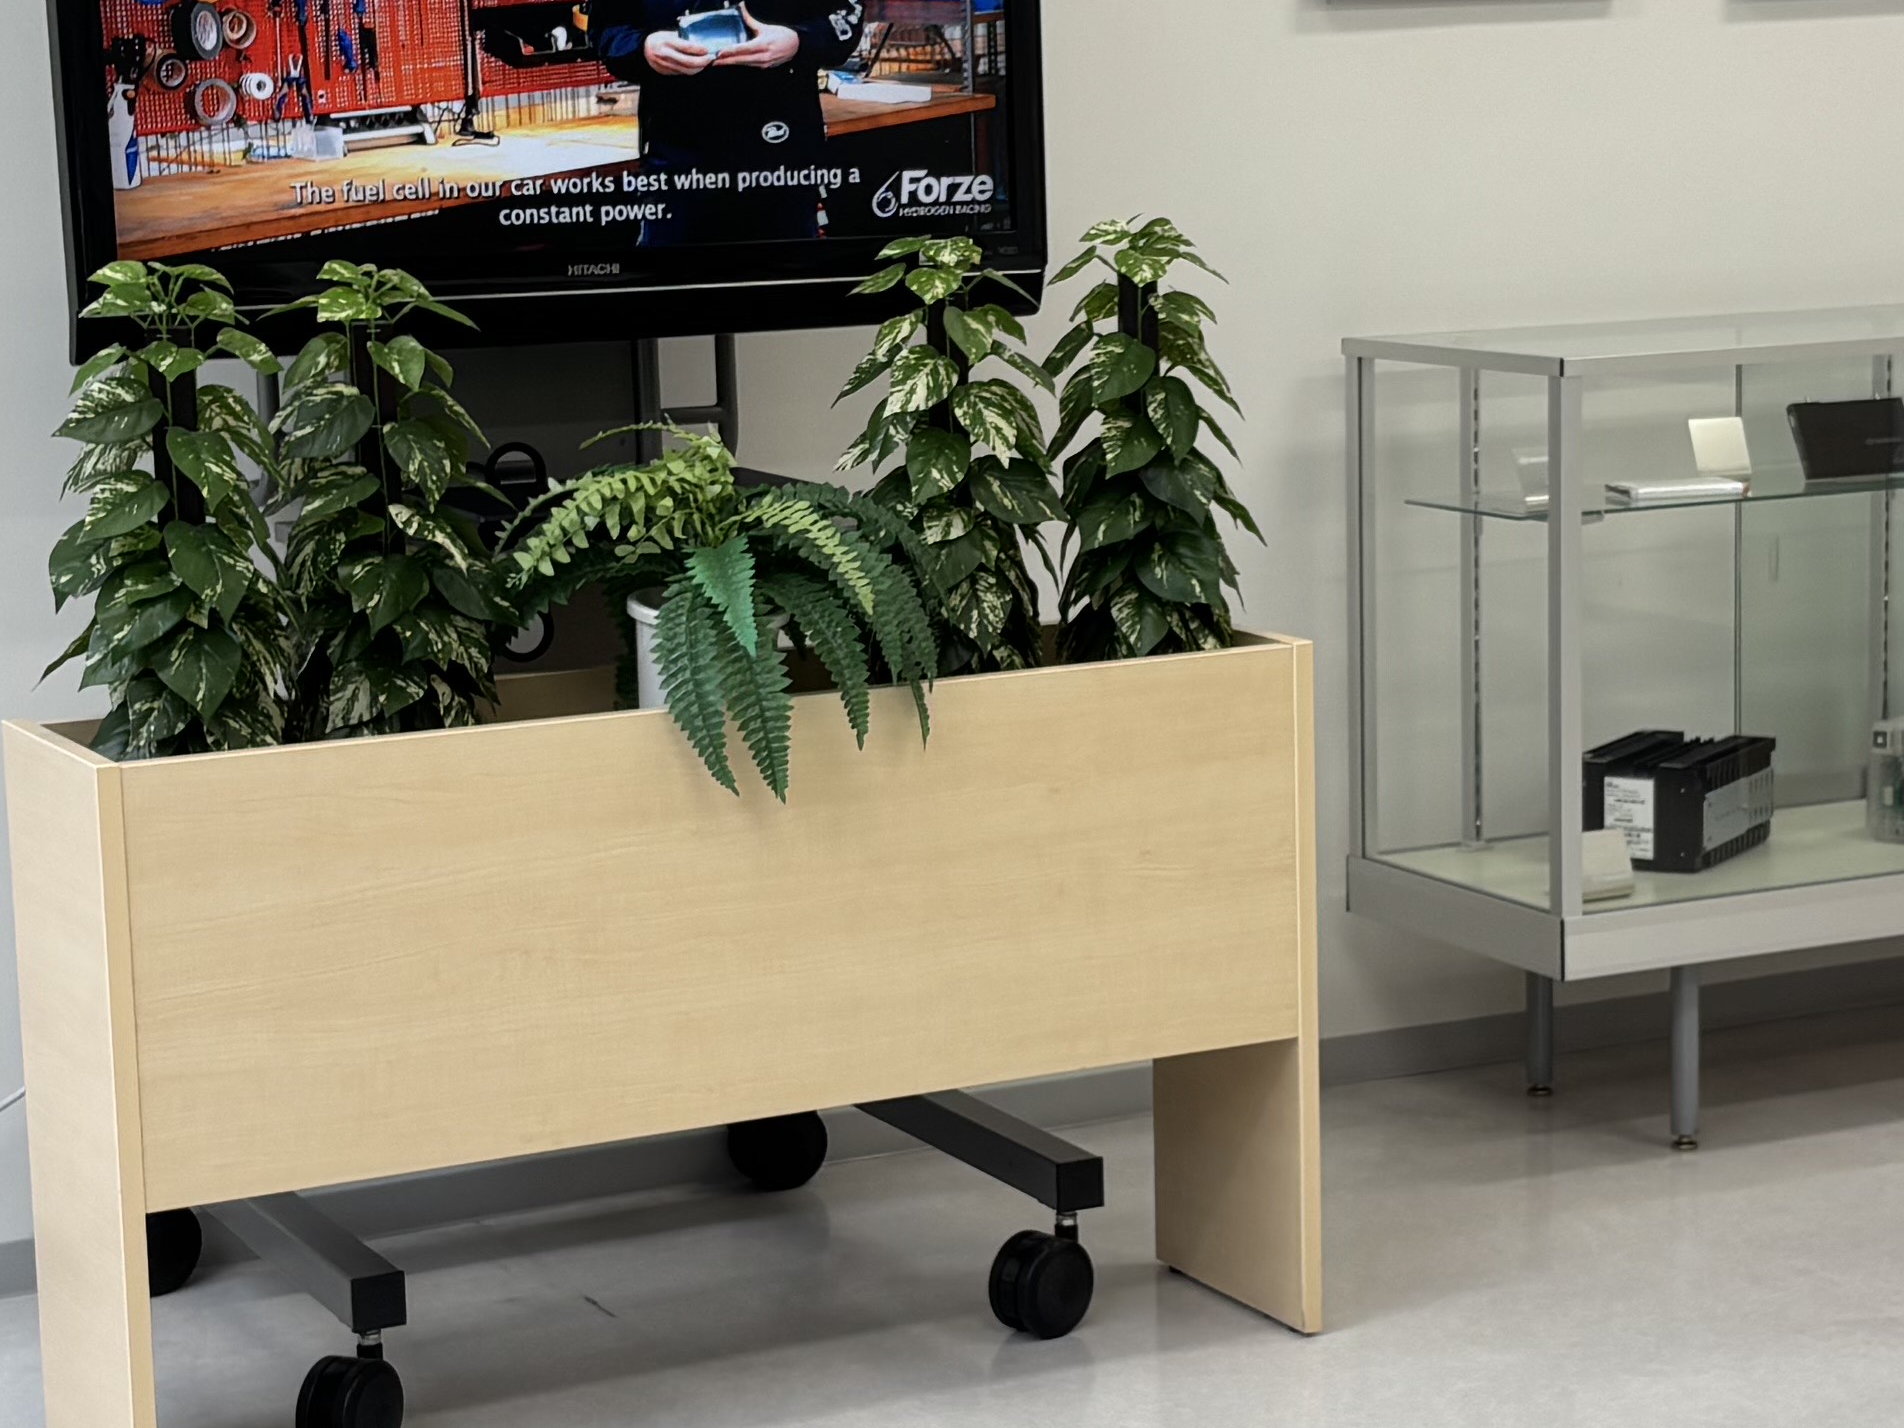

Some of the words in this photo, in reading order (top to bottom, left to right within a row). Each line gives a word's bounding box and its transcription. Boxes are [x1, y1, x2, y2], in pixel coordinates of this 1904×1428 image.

[292, 180, 335, 205] The
[342, 178, 386, 203] fuel
[392, 177, 431, 201] cell
[438, 178, 459, 199] in
[465, 181, 505, 199] our
[510, 179, 544, 196] car
[549, 171, 615, 195] works
[622, 170, 669, 192] best
[673, 167, 731, 191] when
[737, 164, 842, 193] producing
[848, 167, 862, 184] a
[900, 169, 994, 205] Forze
[498, 202, 594, 226] constant
[600, 201, 673, 226] power.
[567, 262, 621, 277] HITACHI
